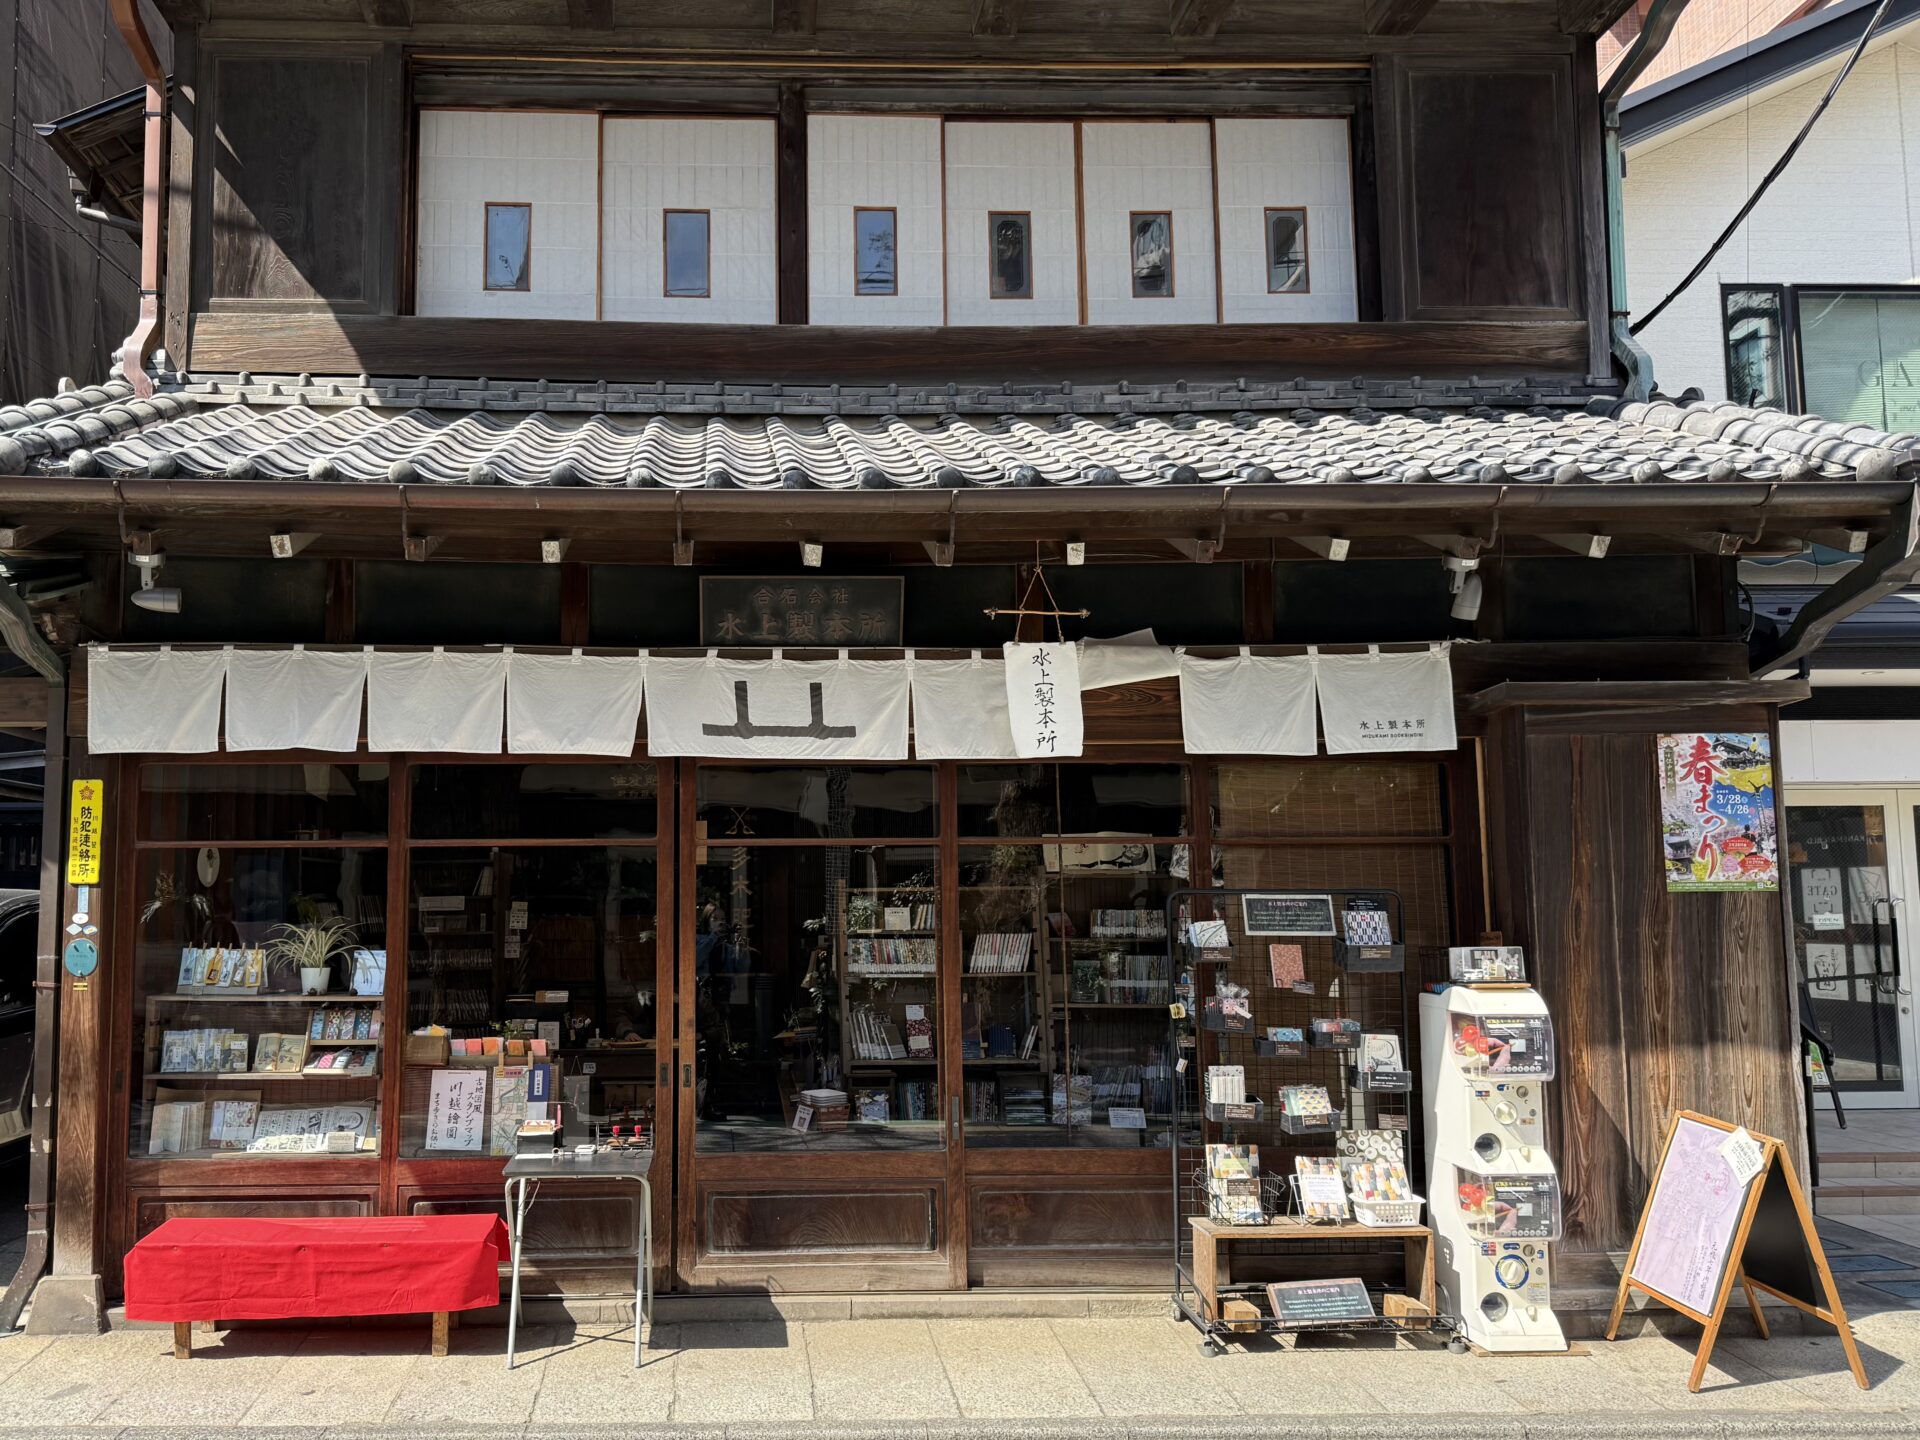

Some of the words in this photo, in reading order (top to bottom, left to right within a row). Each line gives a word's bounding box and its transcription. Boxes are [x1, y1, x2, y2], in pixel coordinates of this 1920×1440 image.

[714, 610, 889, 642] 水上製本所
[1031, 647, 1058, 753] 水上製本所
[1359, 719, 1425, 730] 水上製本所
[77, 806, 93, 879] 防犯連絡所
[1679, 735, 1729, 880] 春まつり
